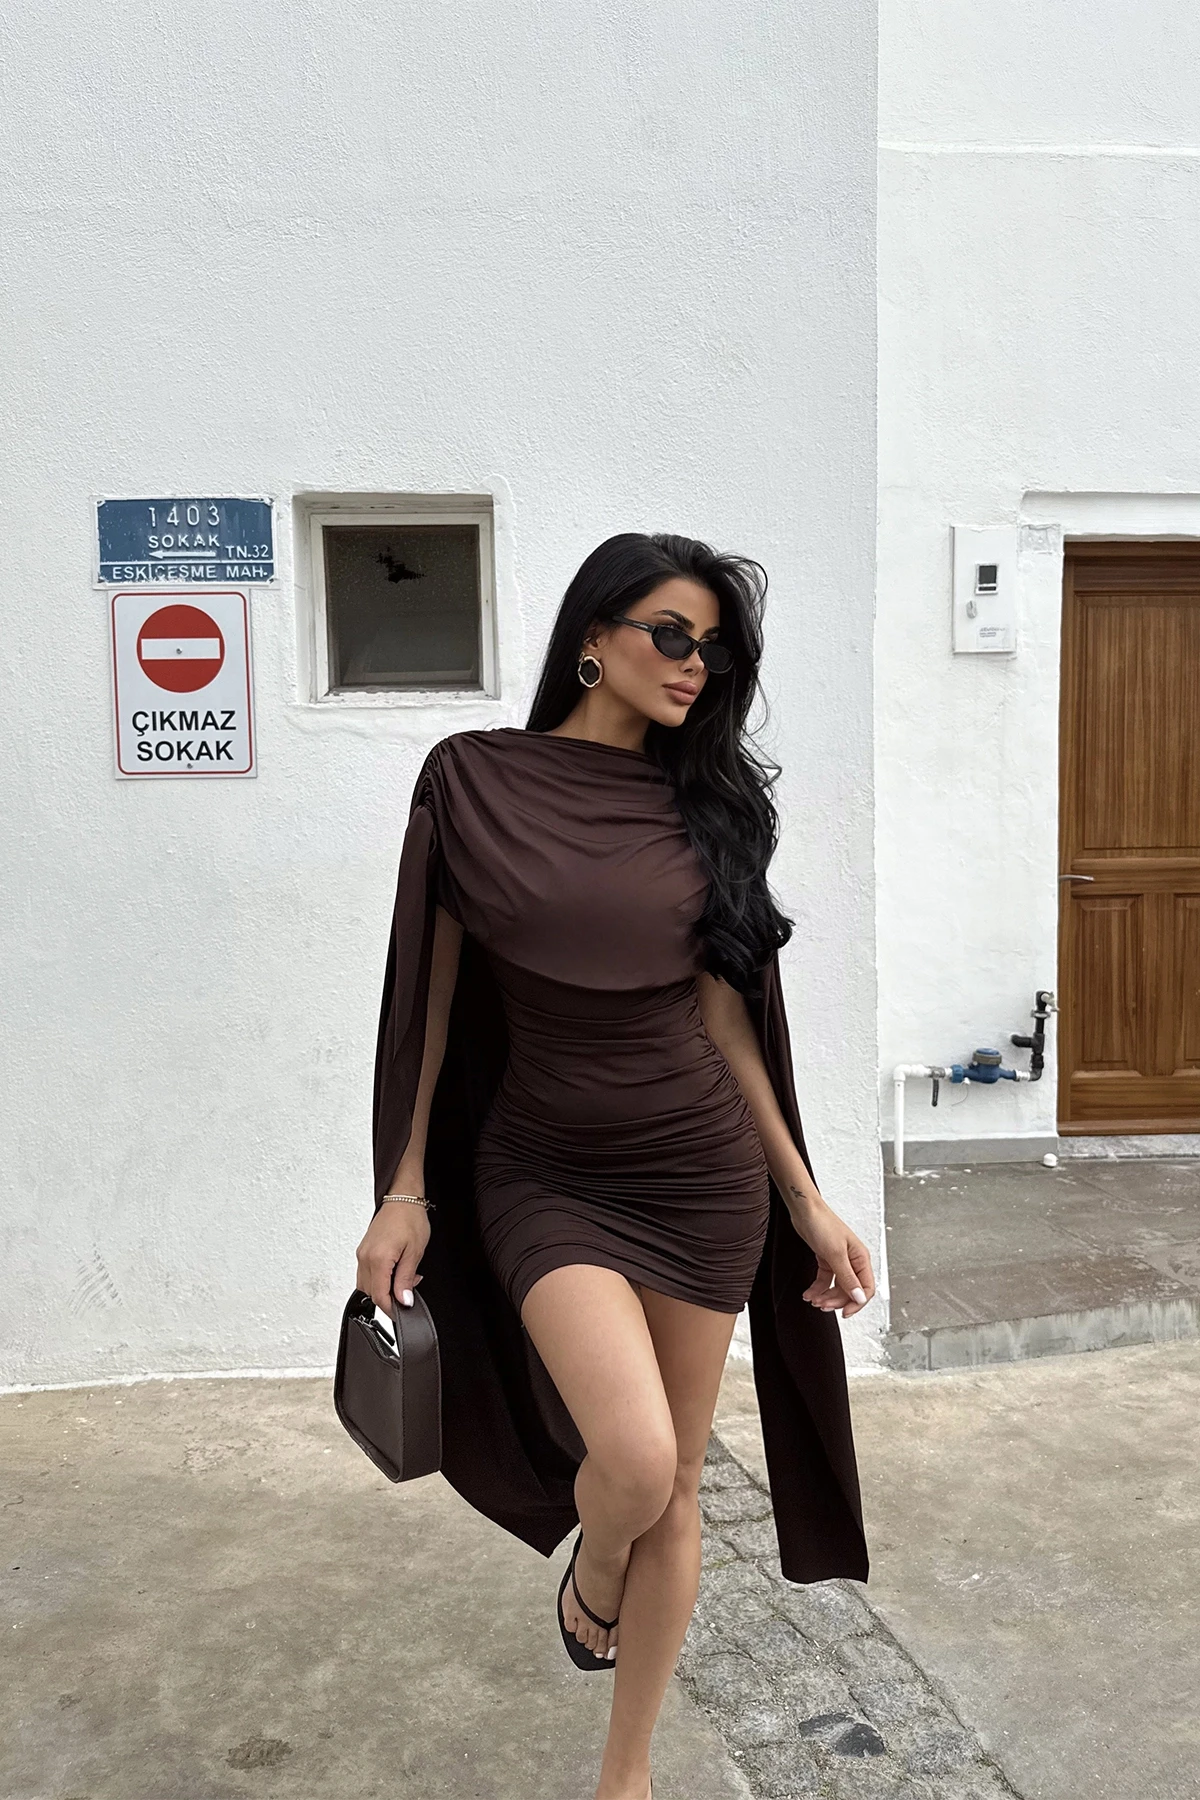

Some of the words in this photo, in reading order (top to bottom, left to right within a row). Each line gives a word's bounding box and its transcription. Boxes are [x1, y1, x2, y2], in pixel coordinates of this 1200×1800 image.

[148, 506, 220, 527] 1403
[148, 535, 220, 549] SOKAK
[225, 544, 269, 558] TN.32
[132, 710, 237, 737] ÇIKMAZ
[137, 740, 234, 762] SOKAK
